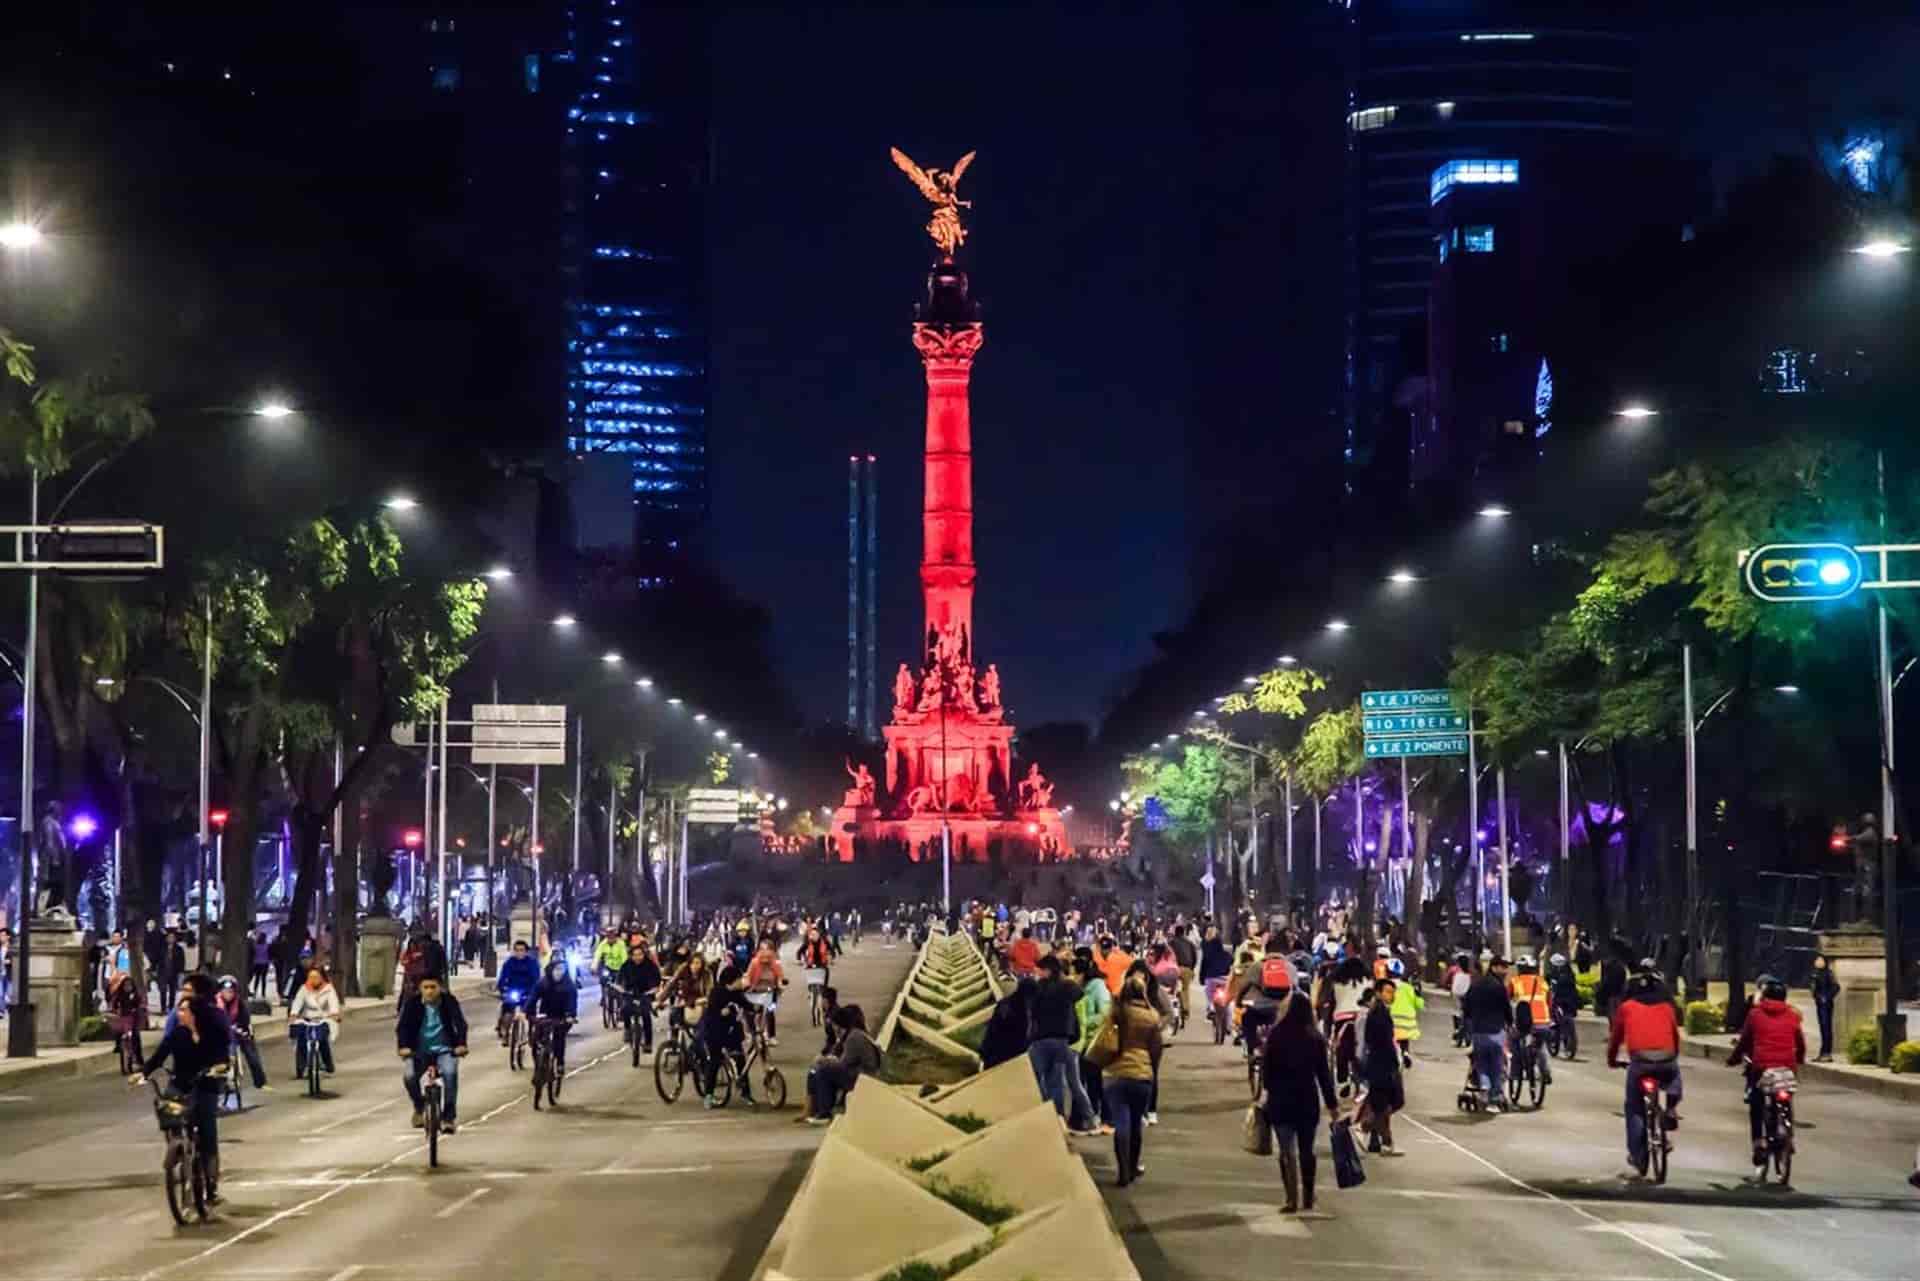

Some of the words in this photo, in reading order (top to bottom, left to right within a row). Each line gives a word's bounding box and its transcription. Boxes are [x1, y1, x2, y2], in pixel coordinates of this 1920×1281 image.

[1400, 717, 1447, 729] TIBER
[1383, 742, 1401, 753] EJE
[1413, 740, 1464, 753] PONIENTE
